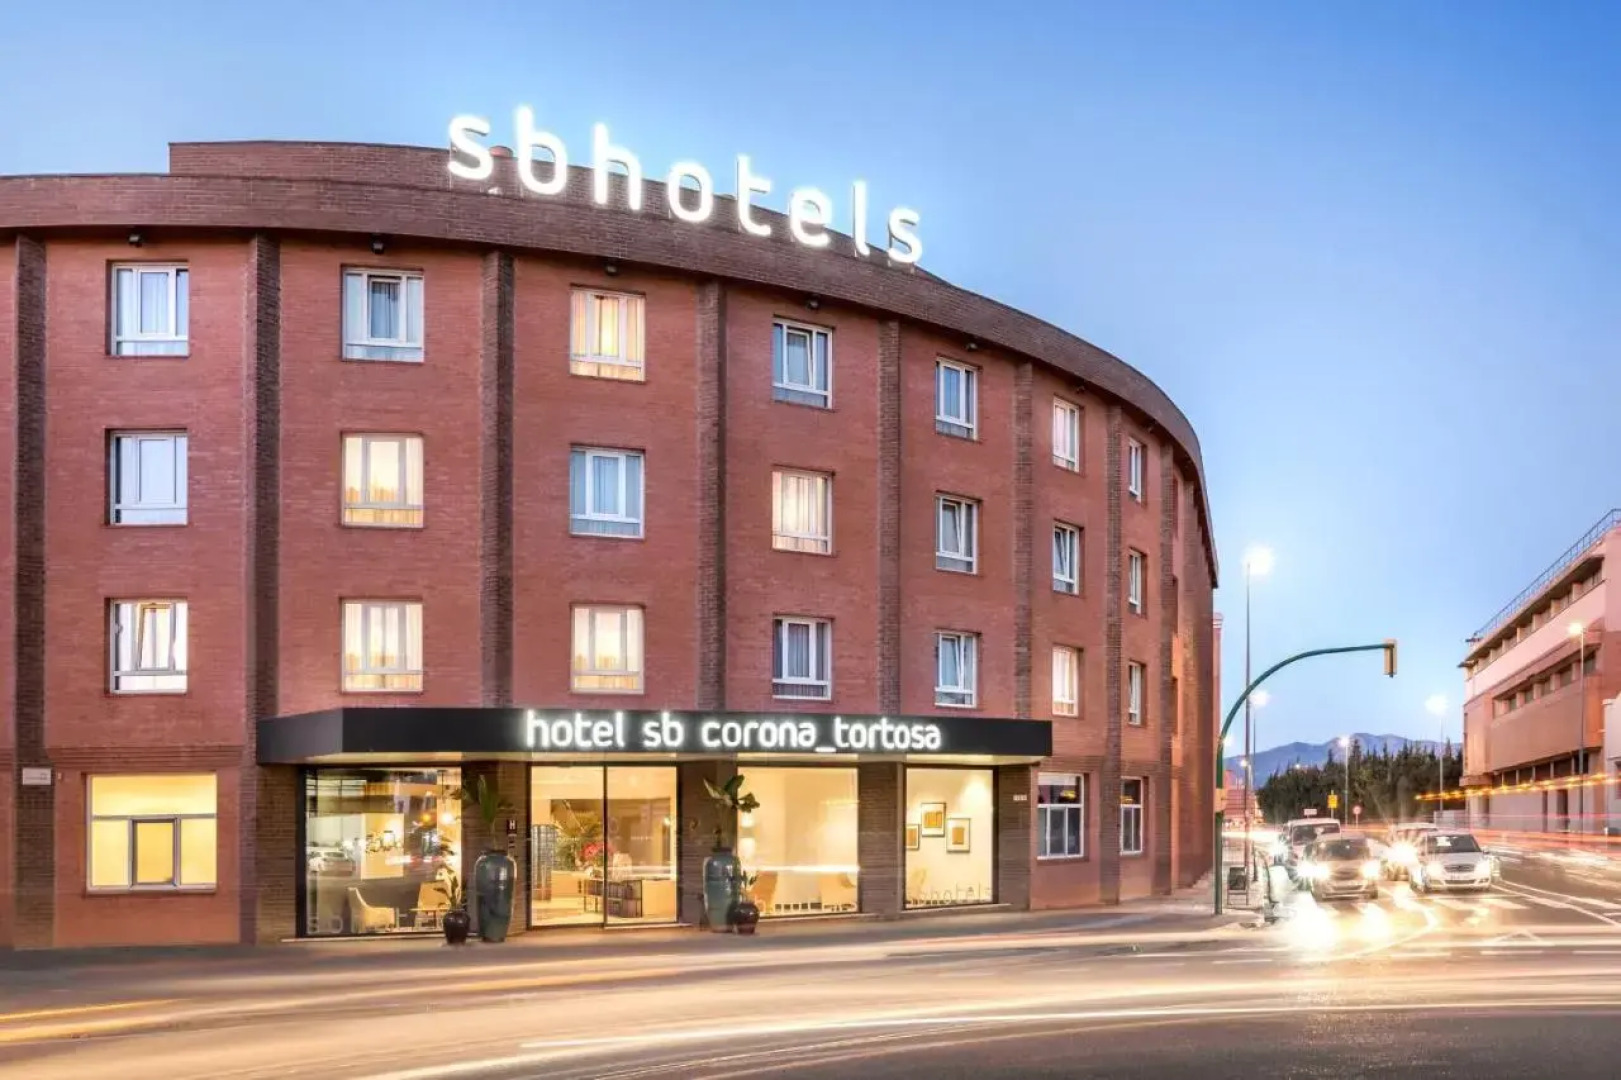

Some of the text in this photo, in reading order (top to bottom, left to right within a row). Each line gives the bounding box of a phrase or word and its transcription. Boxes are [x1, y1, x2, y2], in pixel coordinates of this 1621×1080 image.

[448, 105, 924, 264] sbhotels
[525, 710, 941, 752] hotel sb corona_tortosa
[509, 819, 516, 830] H
